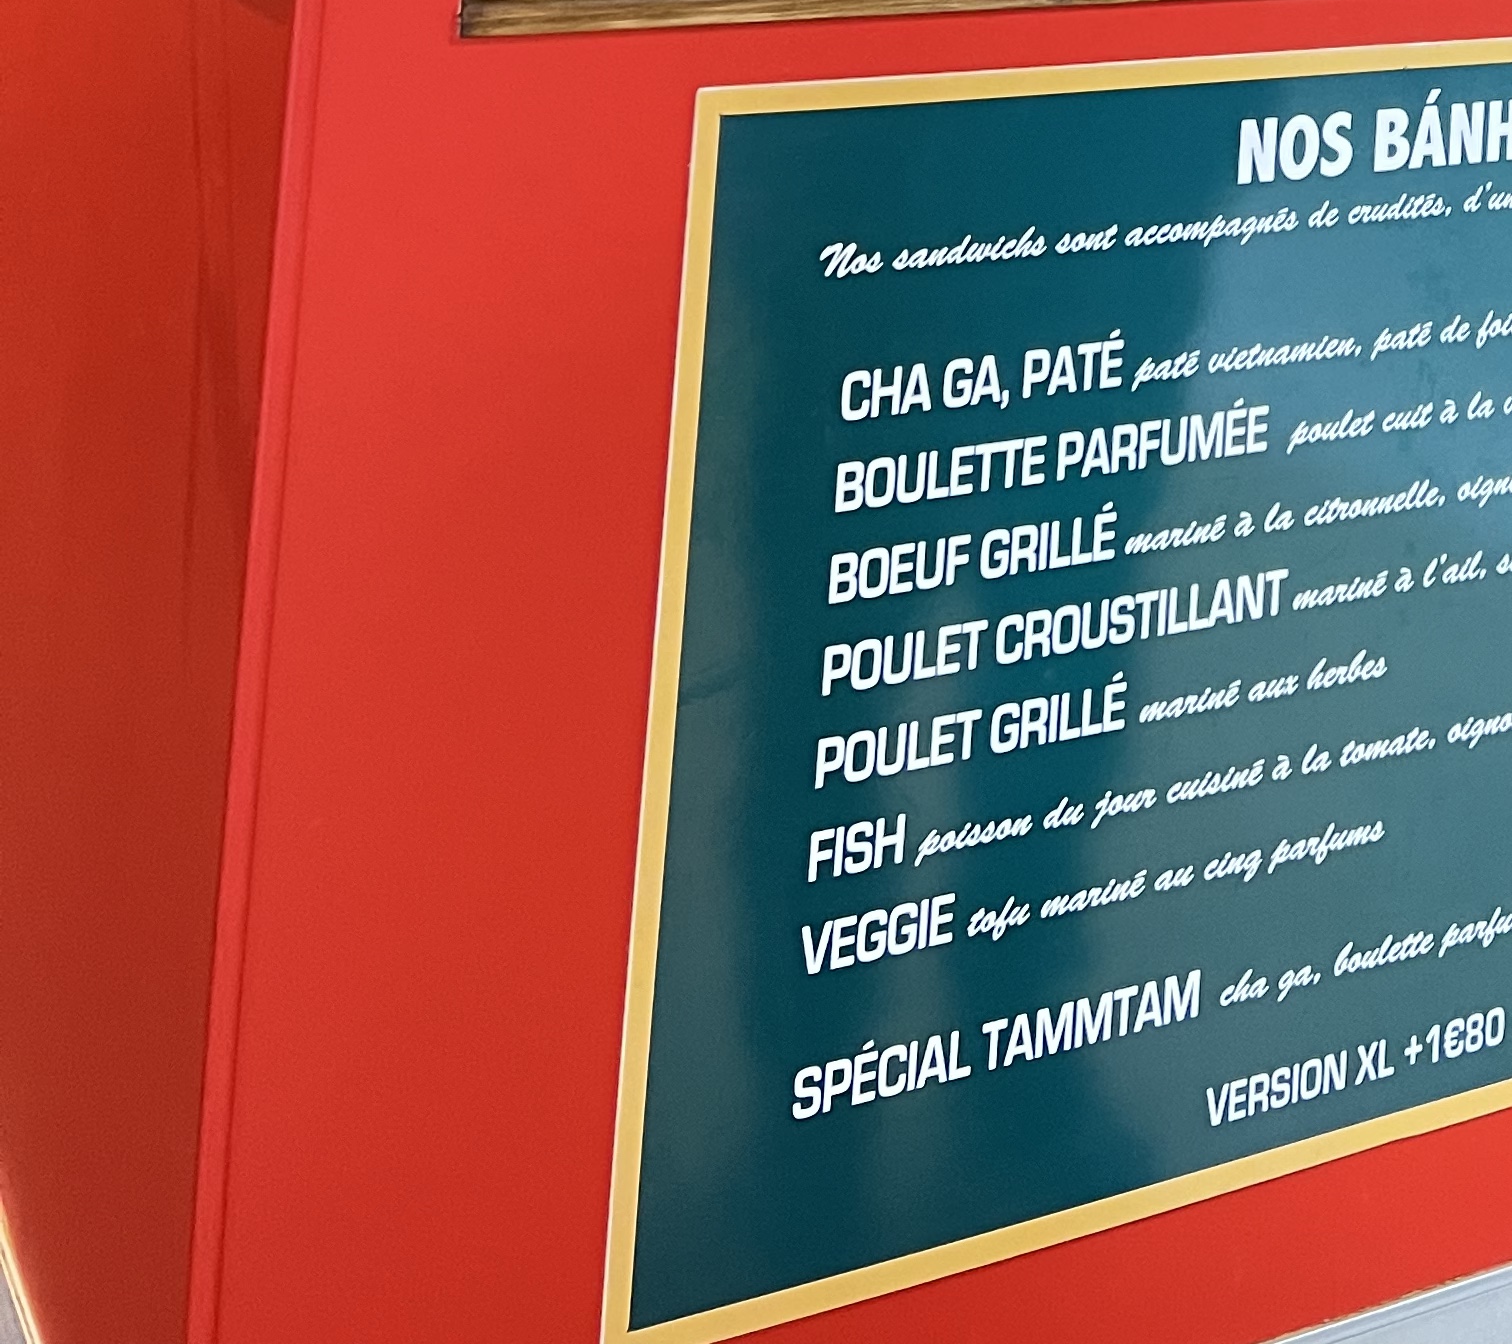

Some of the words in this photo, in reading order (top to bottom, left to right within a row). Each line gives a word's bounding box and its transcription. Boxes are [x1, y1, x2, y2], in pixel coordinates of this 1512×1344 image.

[1237, 110, 1354, 185] NOS
[819, 242, 884, 279] Nos
[891, 225, 1048, 271] sandwichs
[1054, 223, 1119, 254] sont
[1124, 206, 1300, 248] accompagnés
[1307, 199, 1340, 229] de
[1347, 192, 1452, 225] crudités,
[841, 362, 932, 421] CHA
[942, 354, 1010, 410] GA,
[1022, 328, 1125, 399] PATÉ
[1131, 349, 1201, 392] paté
[1207, 335, 1363, 374] vietnamien,
[1369, 320, 1434, 362] paté
[1439, 314, 1472, 344] de
[834, 435, 1048, 513] BOULETTE
[1056, 397, 1270, 482] PARFUMÉE
[1286, 408, 1376, 455] poulet
[1381, 401, 1434, 433] cuit
[1439, 398, 1460, 425] à
[1466, 390, 1496, 421] la
[828, 533, 972, 605] BOEUF
[979, 501, 1118, 580] GRILLÉ
[1124, 514, 1228, 555] mariné
[1233, 510, 1256, 538] à
[1263, 501, 1295, 533] la
[1303, 478, 1446, 527] citronnelle,
[821, 619, 989, 697] POULET
[995, 568, 1290, 665] CROUSTILLANT
[1291, 569, 1389, 611] mariné
[1393, 566, 1415, 593] à
[1422, 549, 1488, 588] l'ail,
[814, 708, 983, 790] POULET
[989, 670, 1128, 754] GRILLÉ
[1138, 678, 1242, 724] mariné
[1247, 674, 1300, 702] aux
[1306, 648, 1388, 691] herbes
[807, 813, 907, 883] FISH
[914, 814, 1034, 867] poisson
[1042, 796, 1085, 830] du
[1090, 788, 1158, 830] jour
[1165, 758, 1266, 804] cuisiné
[1271, 754, 1293, 781] à
[1301, 743, 1333, 775] la
[1339, 726, 1437, 768] tomate,
[801, 892, 956, 975] VEGGIE
[966, 895, 1031, 942] tofu
[1040, 869, 1148, 919] mariné
[1153, 864, 1195, 891] au
[1203, 849, 1264, 883] cinq
[1267, 820, 1386, 875] parfums
[792, 1030, 972, 1120] SPÉCIAL
[981, 969, 1202, 1071] TAMMTAM
[1219, 968, 1270, 1007] cha
[1276, 964, 1322, 1003] ga,
[1333, 930, 1435, 977] boulette
[1206, 1049, 1348, 1127] VERSION
[1354, 1038, 1395, 1086] XL
[1403, 1006, 1506, 1066] +1€80
